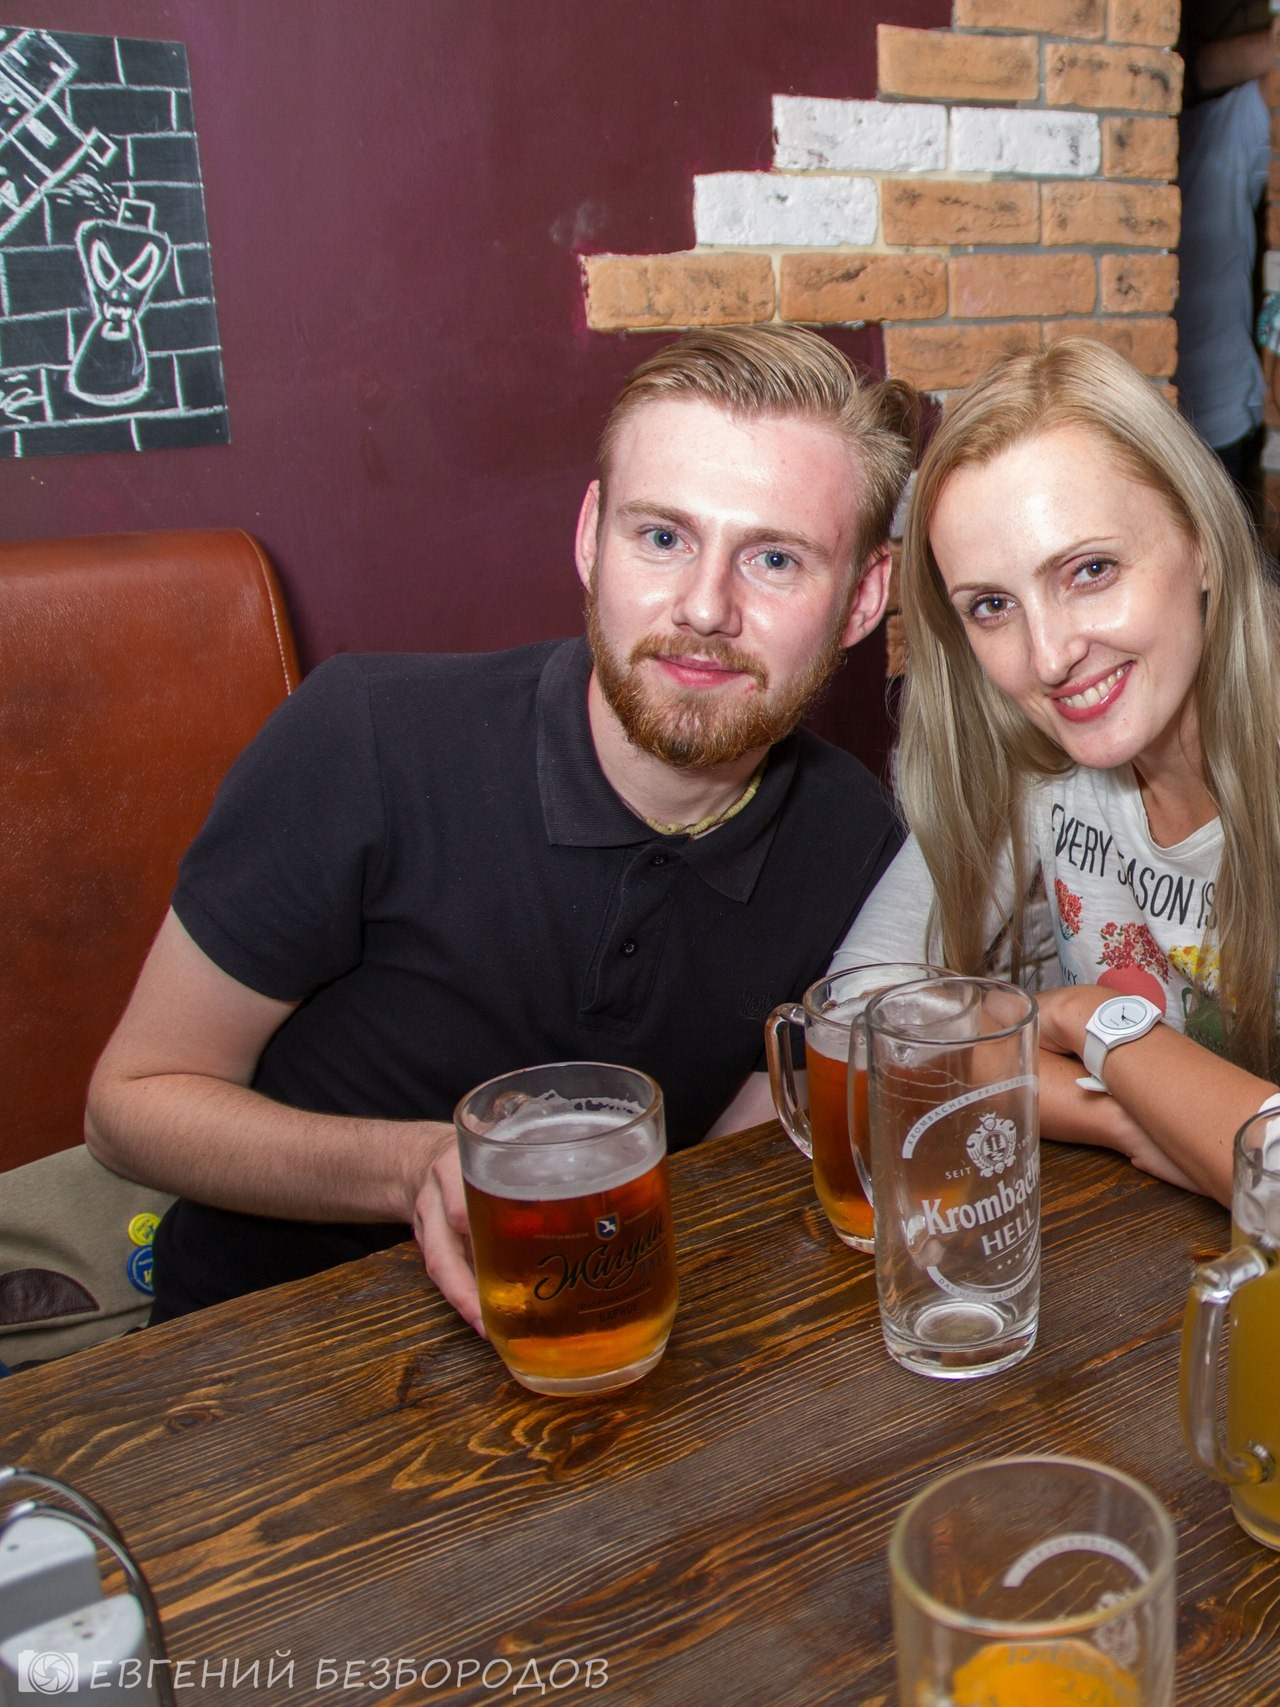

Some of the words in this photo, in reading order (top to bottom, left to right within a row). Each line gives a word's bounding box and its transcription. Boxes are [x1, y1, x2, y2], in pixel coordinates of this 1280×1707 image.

[907, 1095, 971, 1146] KROMBACHER
[921, 1150, 1040, 1236] Krombach
[944, 1166, 973, 1180] SEIT
[981, 1207, 1035, 1256] HELL
